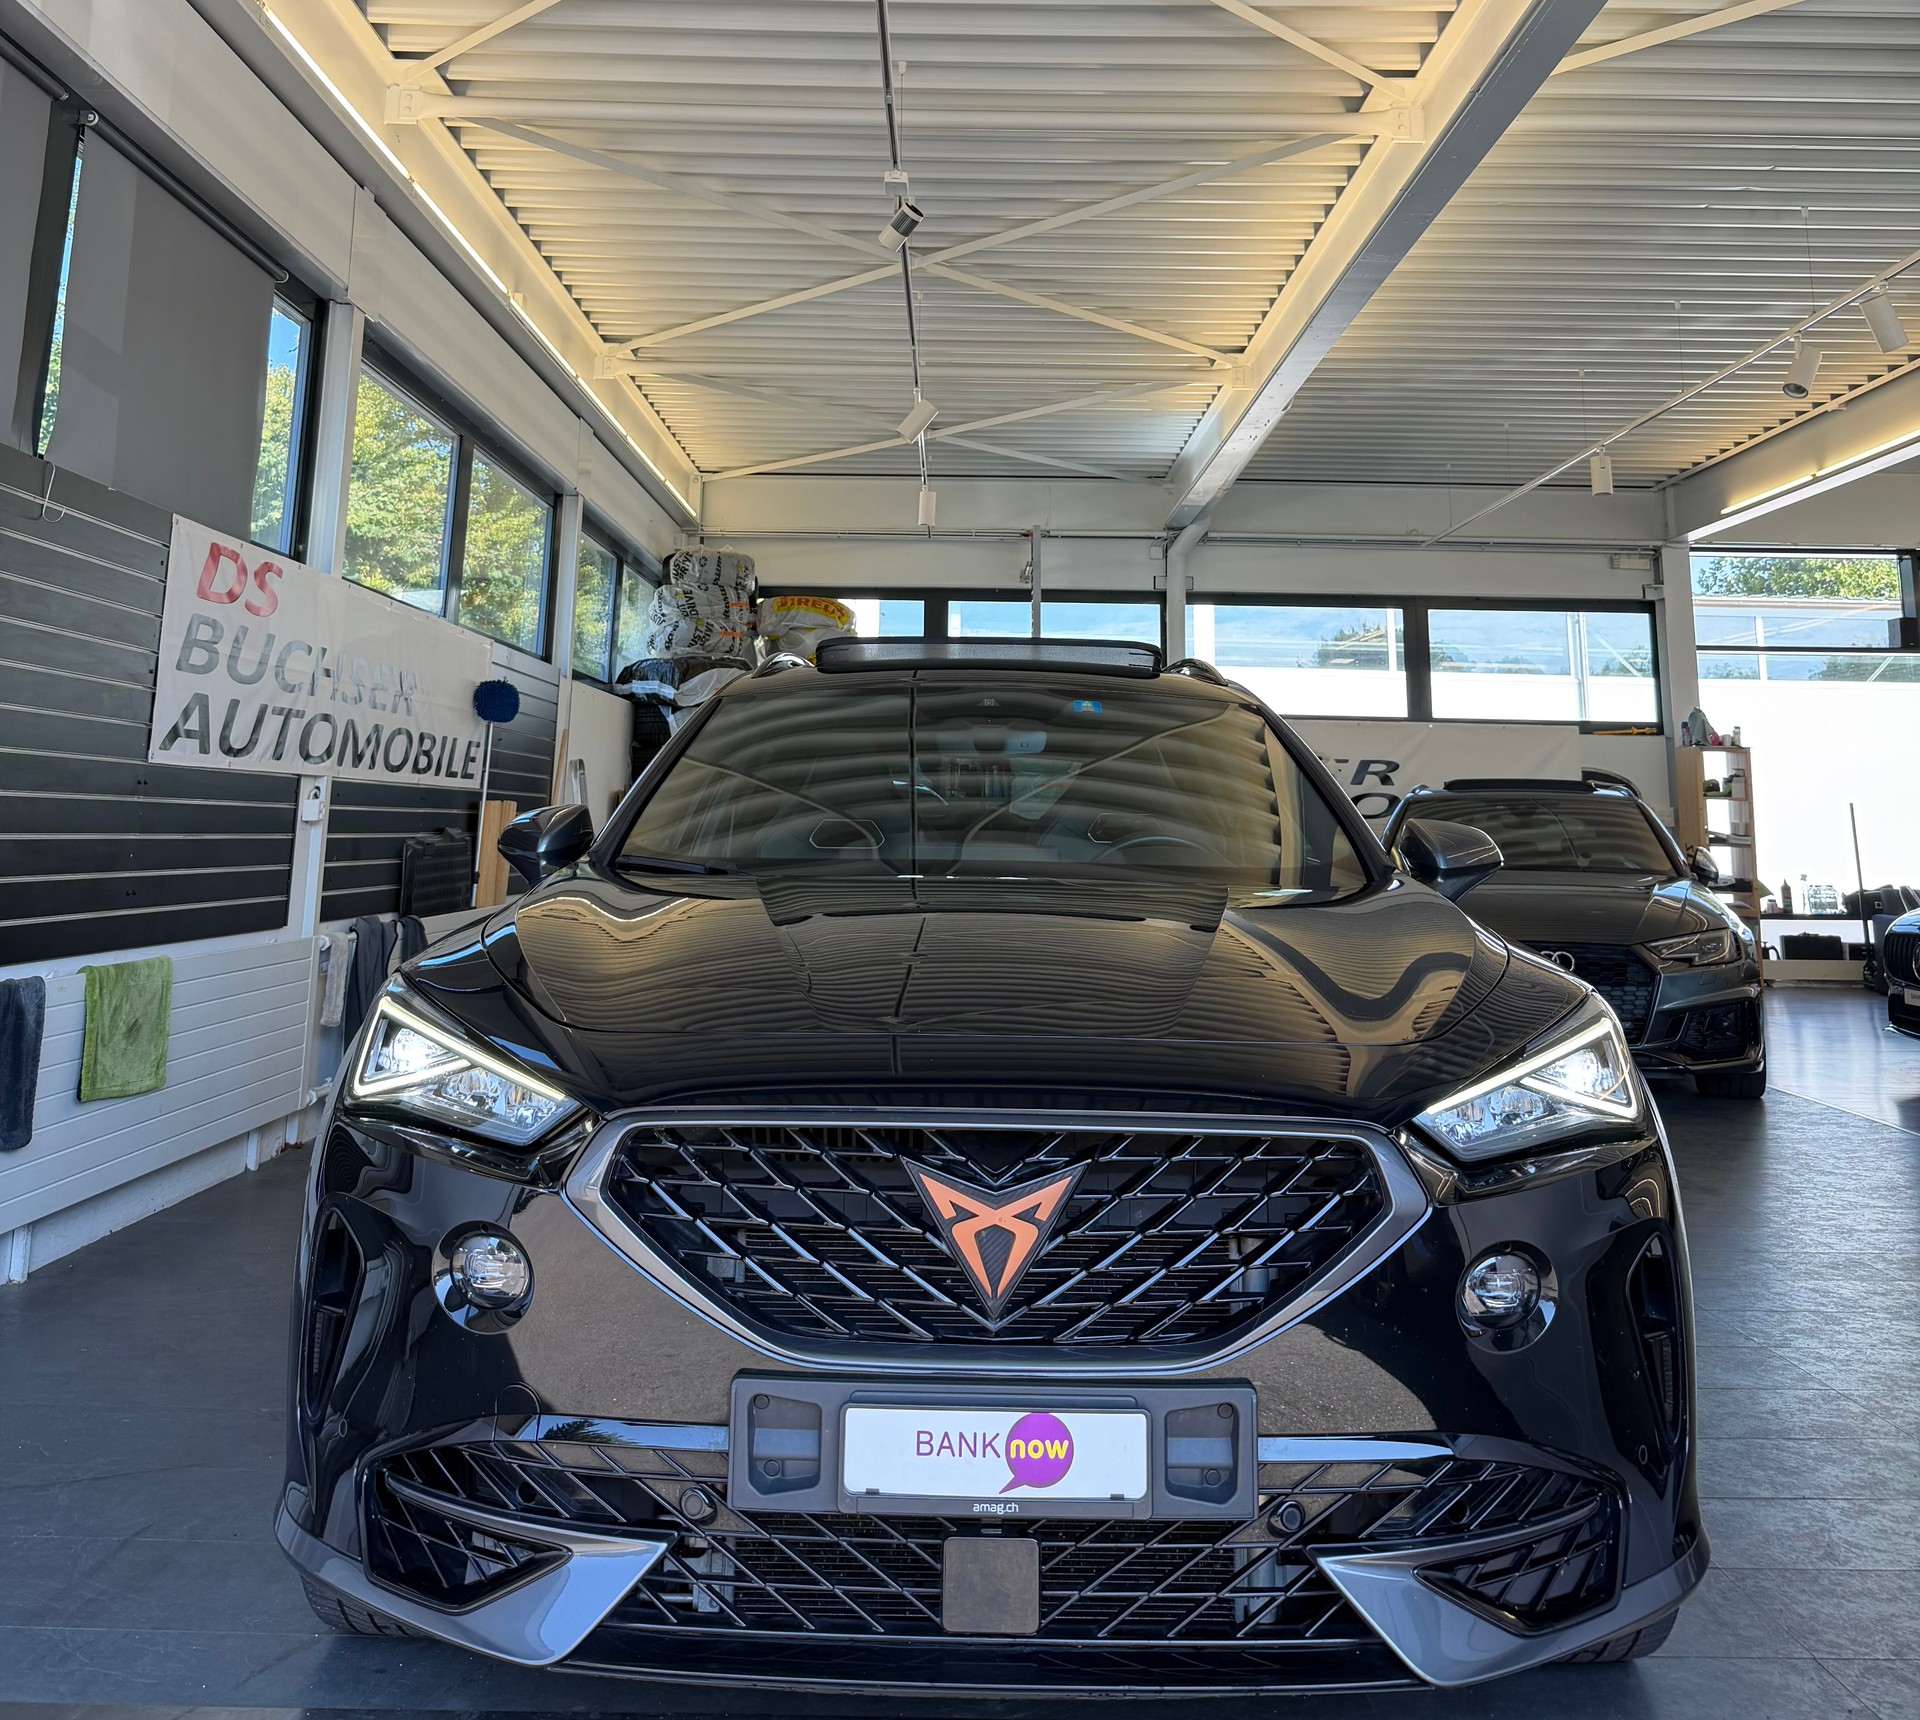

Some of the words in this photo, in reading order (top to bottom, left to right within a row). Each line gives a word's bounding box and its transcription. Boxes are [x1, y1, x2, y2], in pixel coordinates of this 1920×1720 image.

[196, 542, 284, 617] DS
[175, 613, 417, 717] BUCHSER
[159, 692, 481, 780] AUTOMOBILE
[916, 1430, 1001, 1458] BANK
[1010, 1439, 1069, 1459] now
[972, 1502, 1020, 1515] amag.ch
